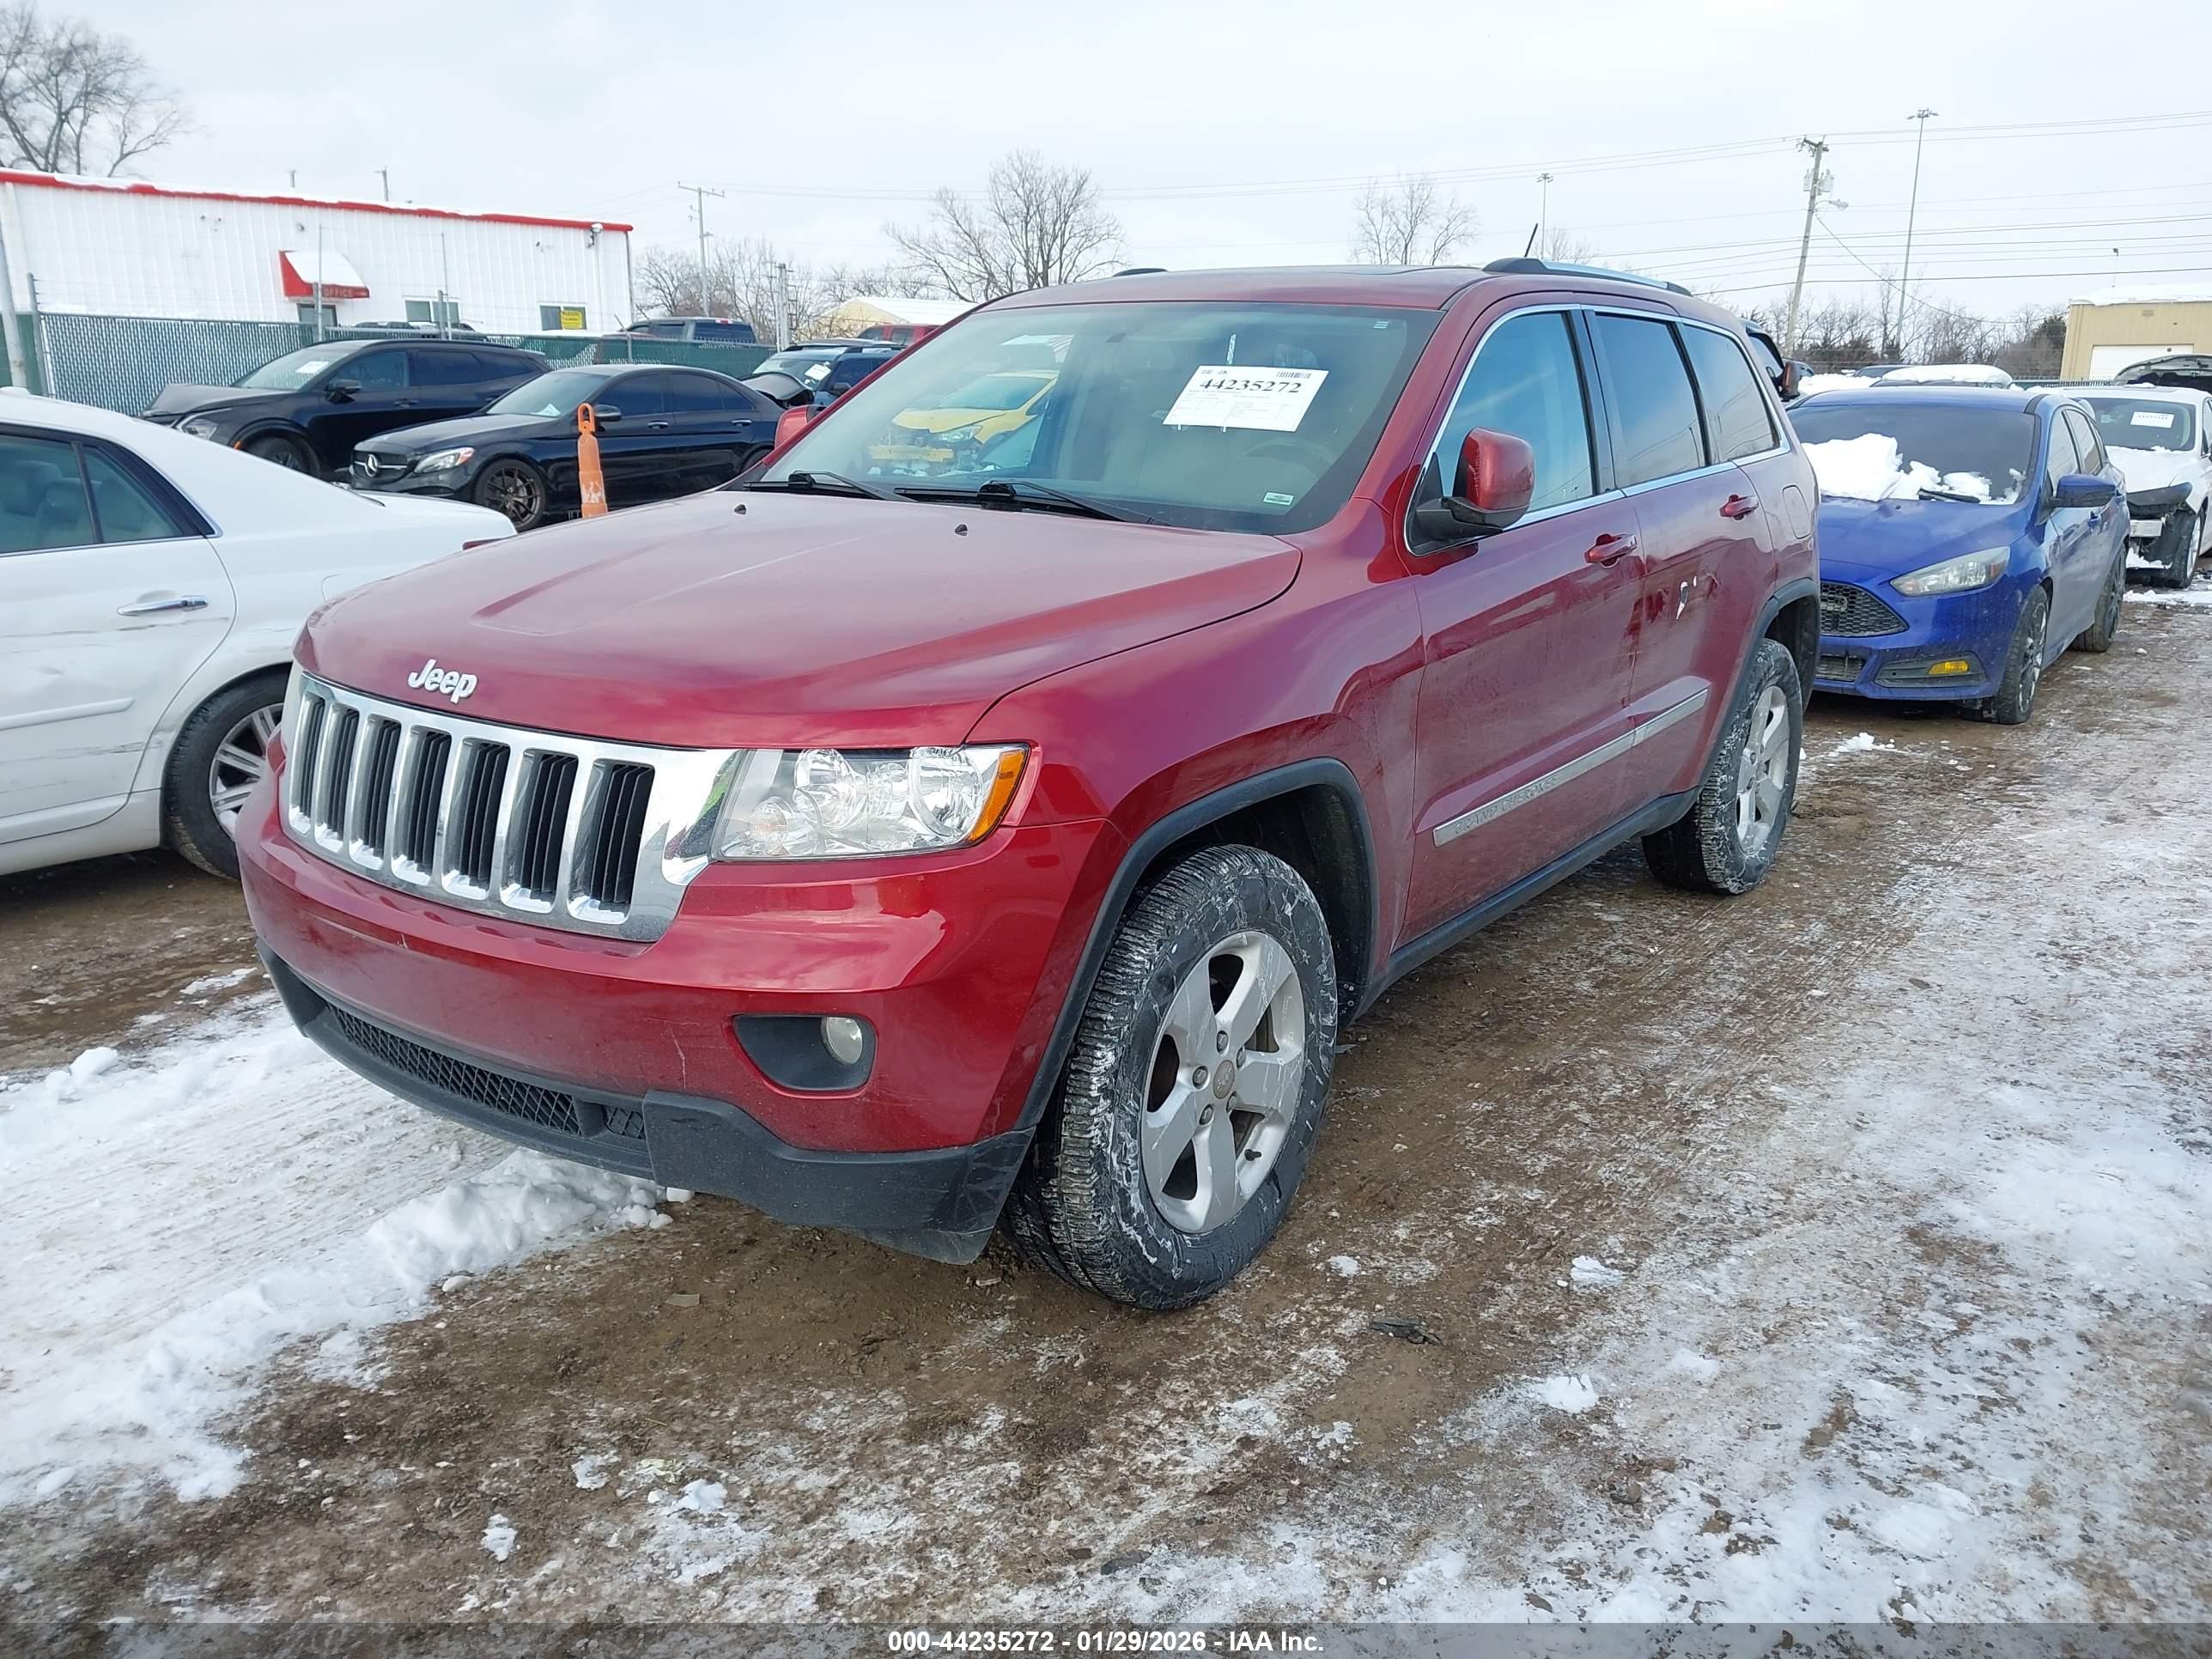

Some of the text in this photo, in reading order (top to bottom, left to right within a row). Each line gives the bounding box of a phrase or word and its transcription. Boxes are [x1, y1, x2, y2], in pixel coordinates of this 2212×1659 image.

[324, 288, 354, 297] OFFICE
[1200, 378, 1303, 394] 44235272
[407, 659, 478, 704] Jeep
